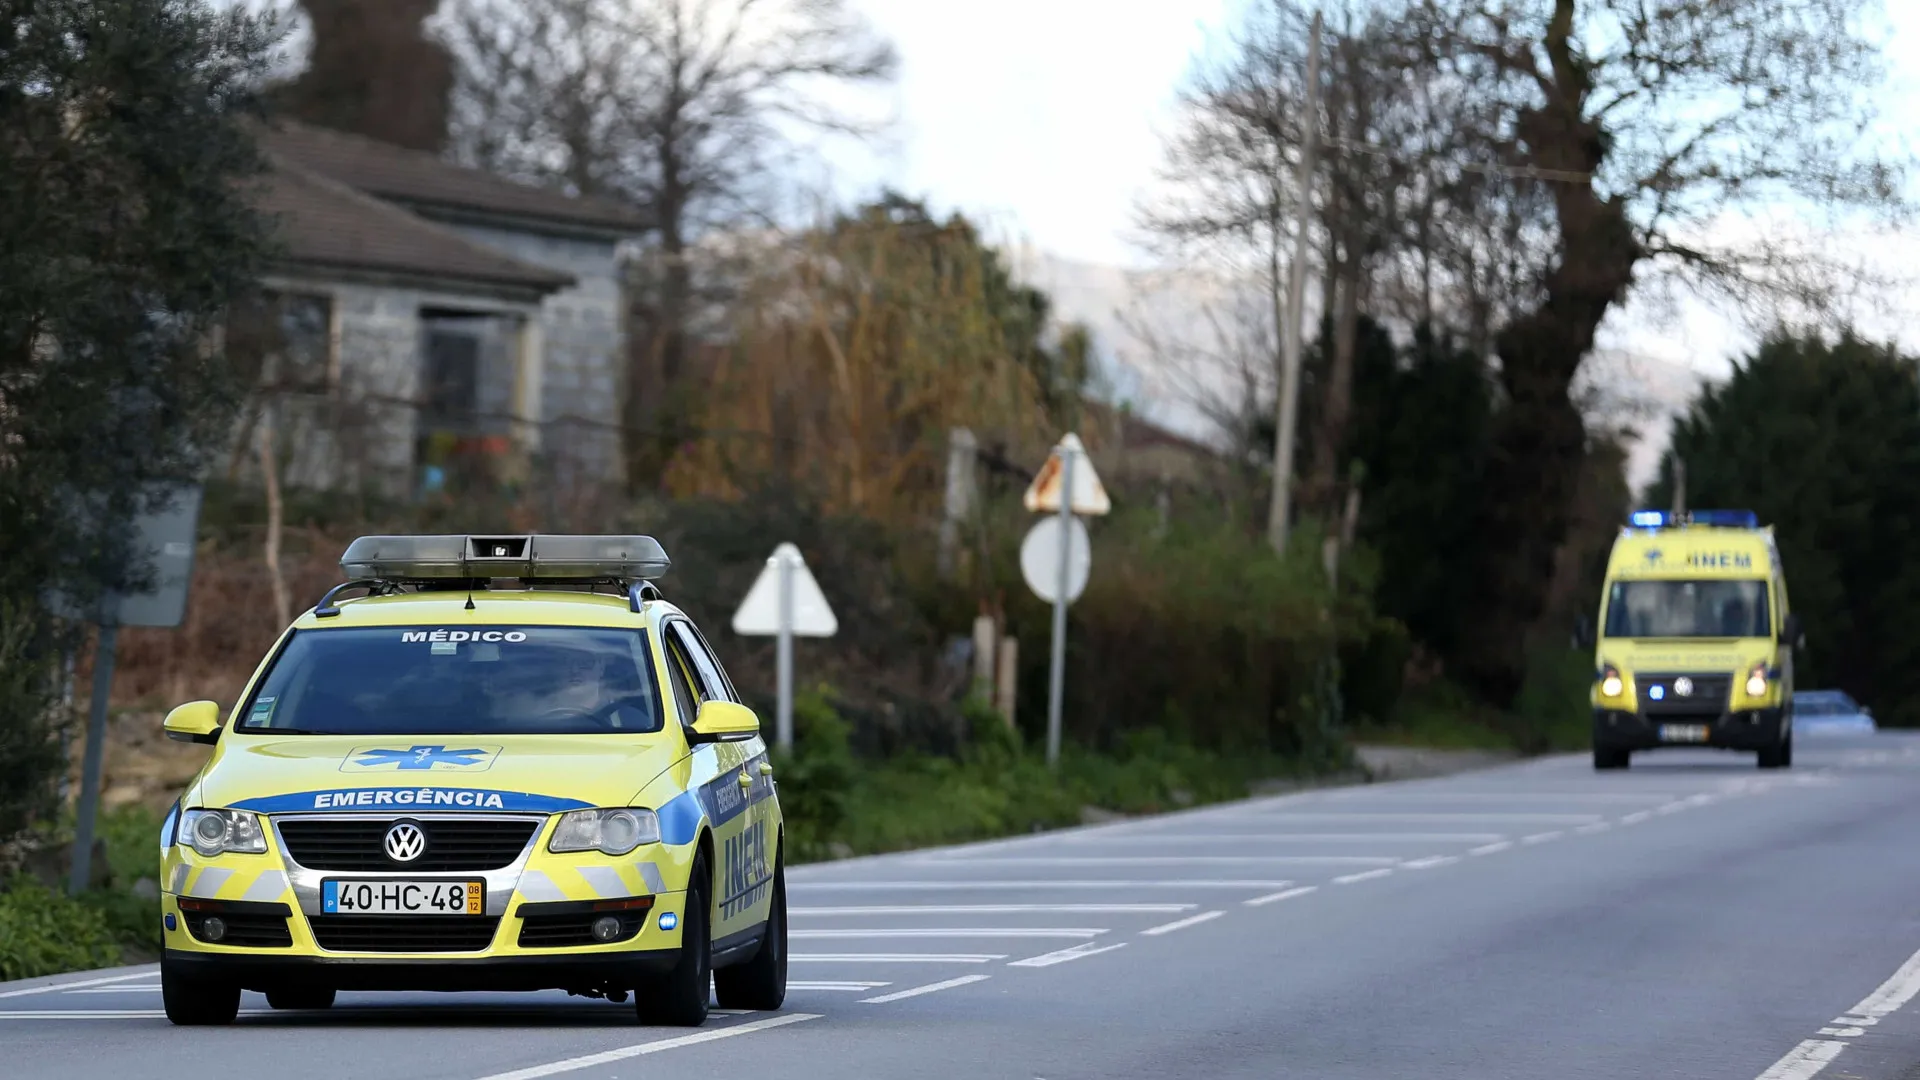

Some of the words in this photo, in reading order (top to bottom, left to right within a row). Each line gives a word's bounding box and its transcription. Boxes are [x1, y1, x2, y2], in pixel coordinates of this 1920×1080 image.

[1693, 551, 1751, 568] INEM
[401, 629, 527, 643] MÉDICO
[314, 788, 504, 809] EMERGÊNCIA
[385, 823, 425, 861] VW
[723, 820, 766, 921] INEM
[468, 886, 480, 895] 08
[327, 900, 334, 908] P
[469, 902, 479, 911] 12
